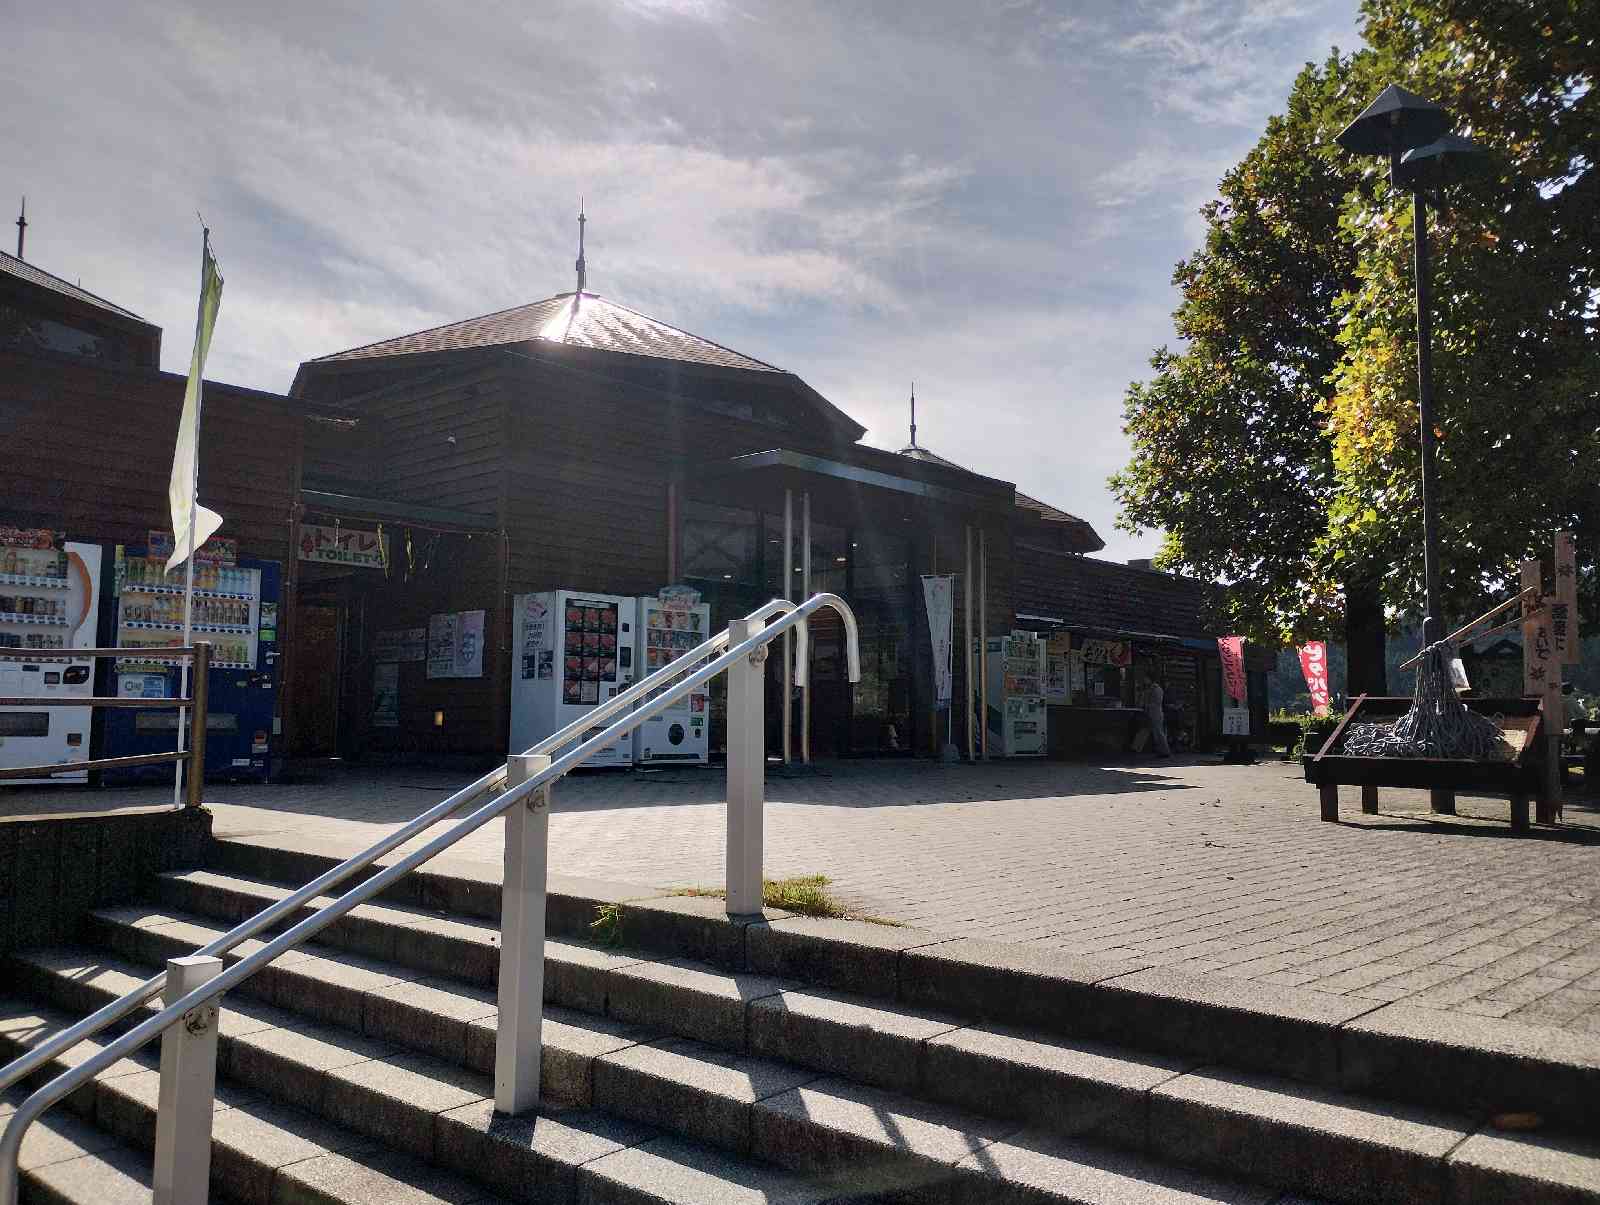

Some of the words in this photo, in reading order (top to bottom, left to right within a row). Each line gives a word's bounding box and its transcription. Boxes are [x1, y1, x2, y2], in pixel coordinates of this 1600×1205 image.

[315, 528, 377, 552] トイレ
[315, 548, 372, 564] TOILET
